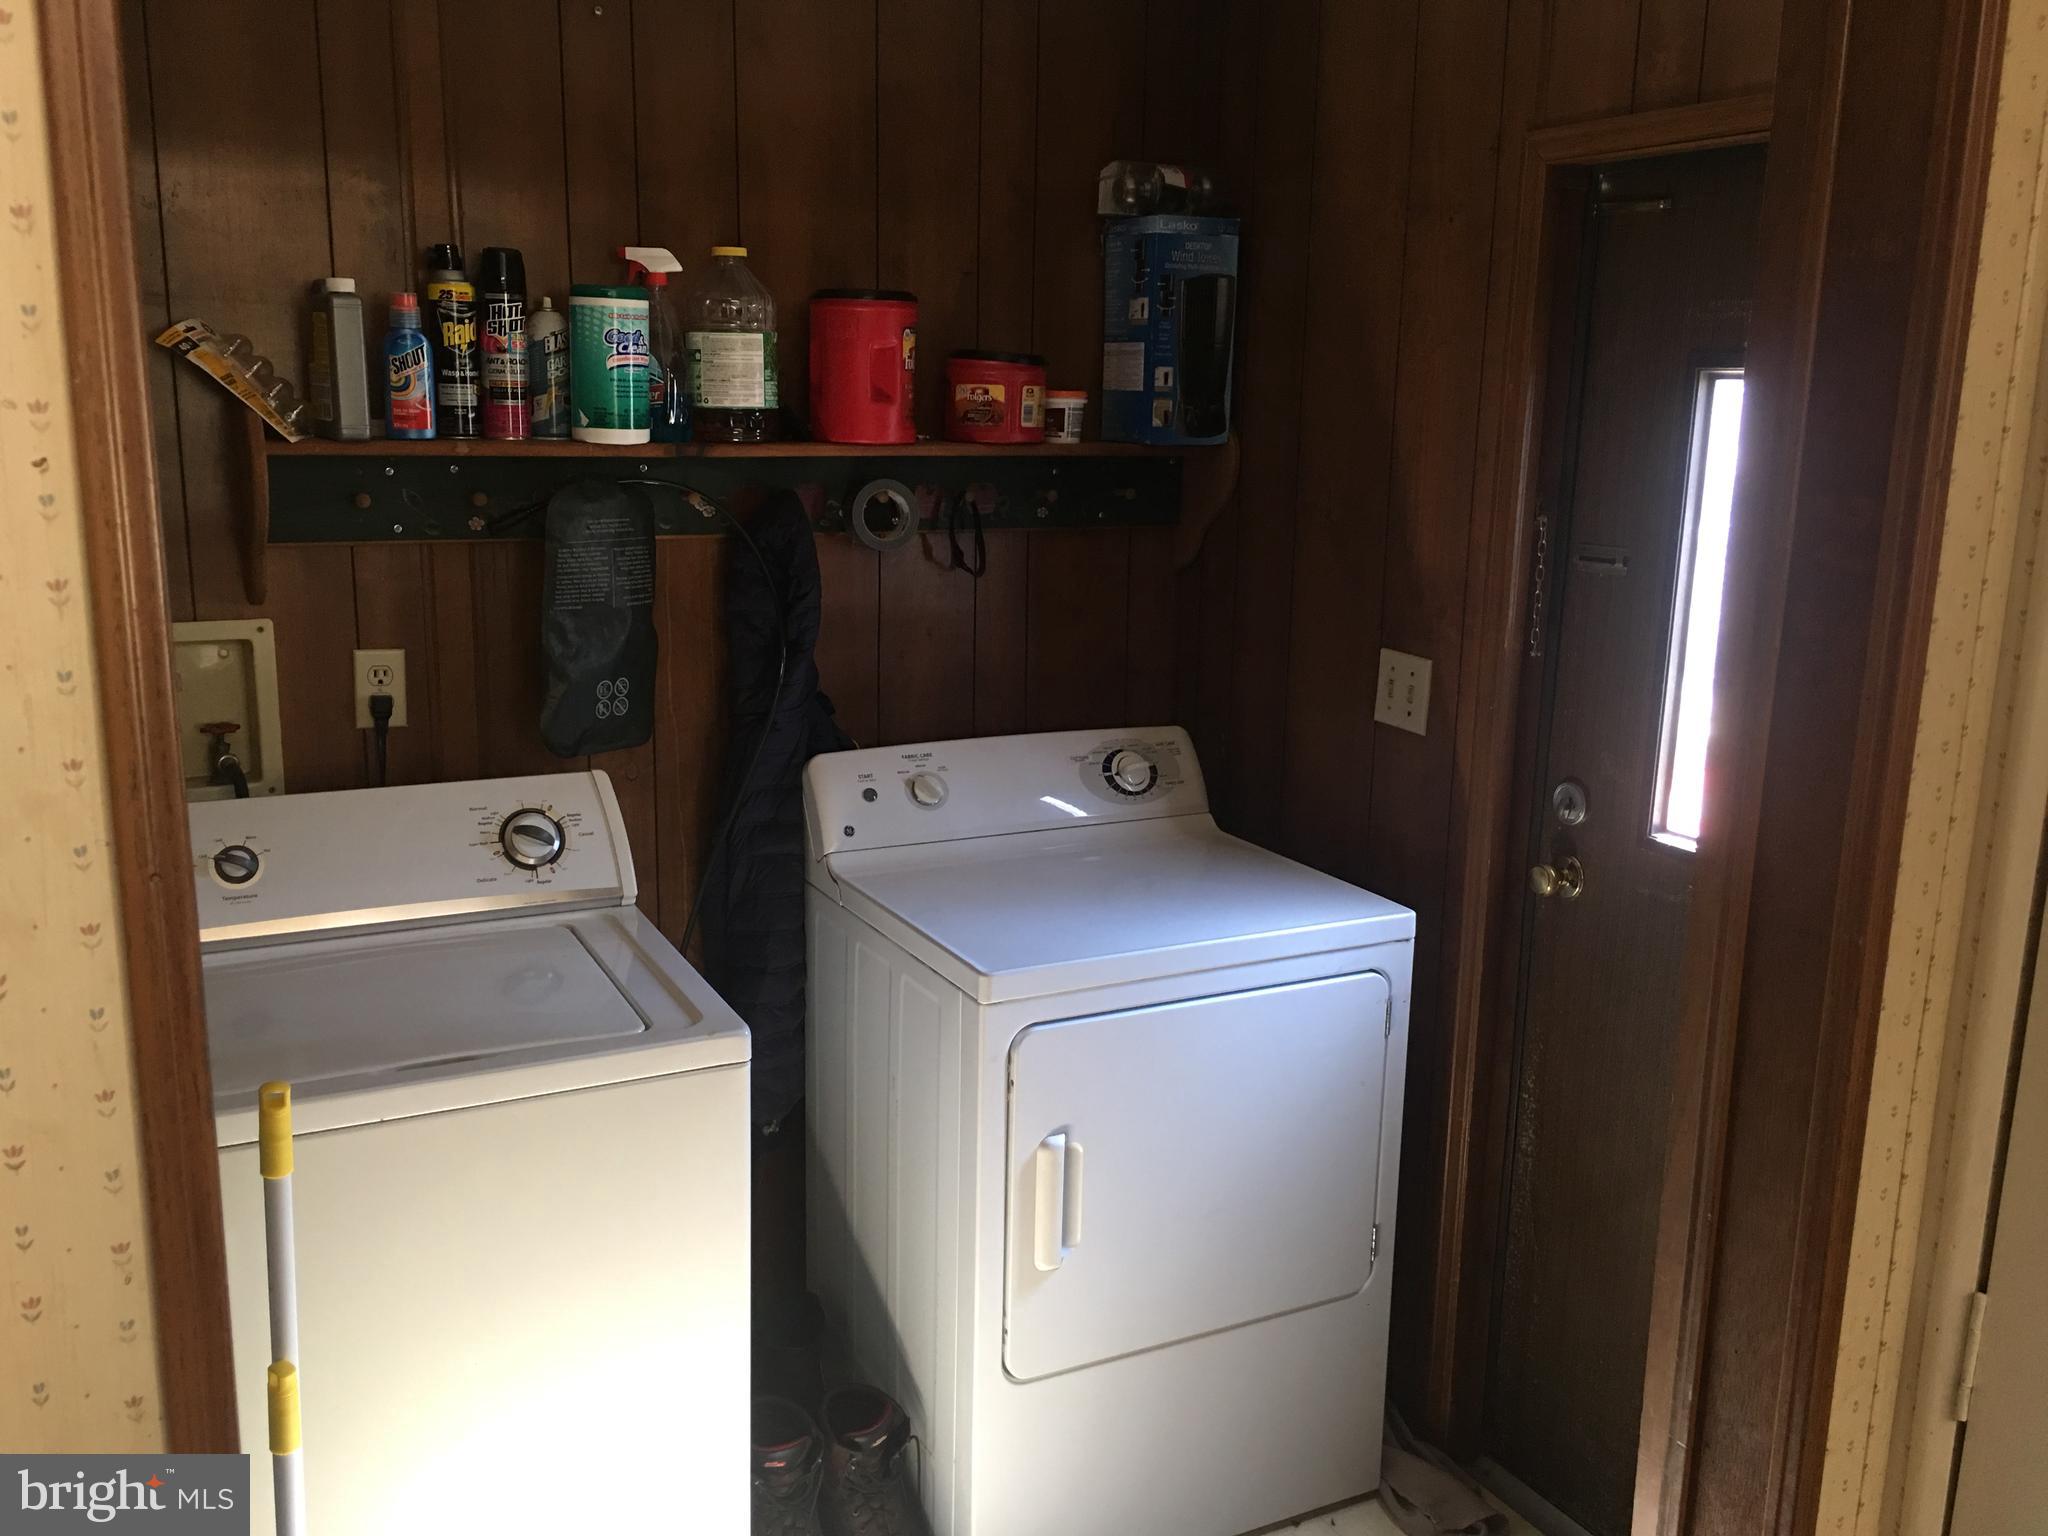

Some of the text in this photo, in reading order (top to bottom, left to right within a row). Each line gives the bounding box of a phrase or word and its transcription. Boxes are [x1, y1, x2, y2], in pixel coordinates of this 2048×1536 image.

[1159, 219, 1197, 231] Lasko
[489, 302, 522, 320] HOT
[442, 319, 477, 347] Raid
[487, 317, 525, 336] SHOT
[604, 328, 641, 345] Good
[618, 343, 647, 354] Clean
[391, 345, 426, 375] SHOUT
[441, 369, 460, 378] Wasp
[967, 392, 992, 403] Folgers
